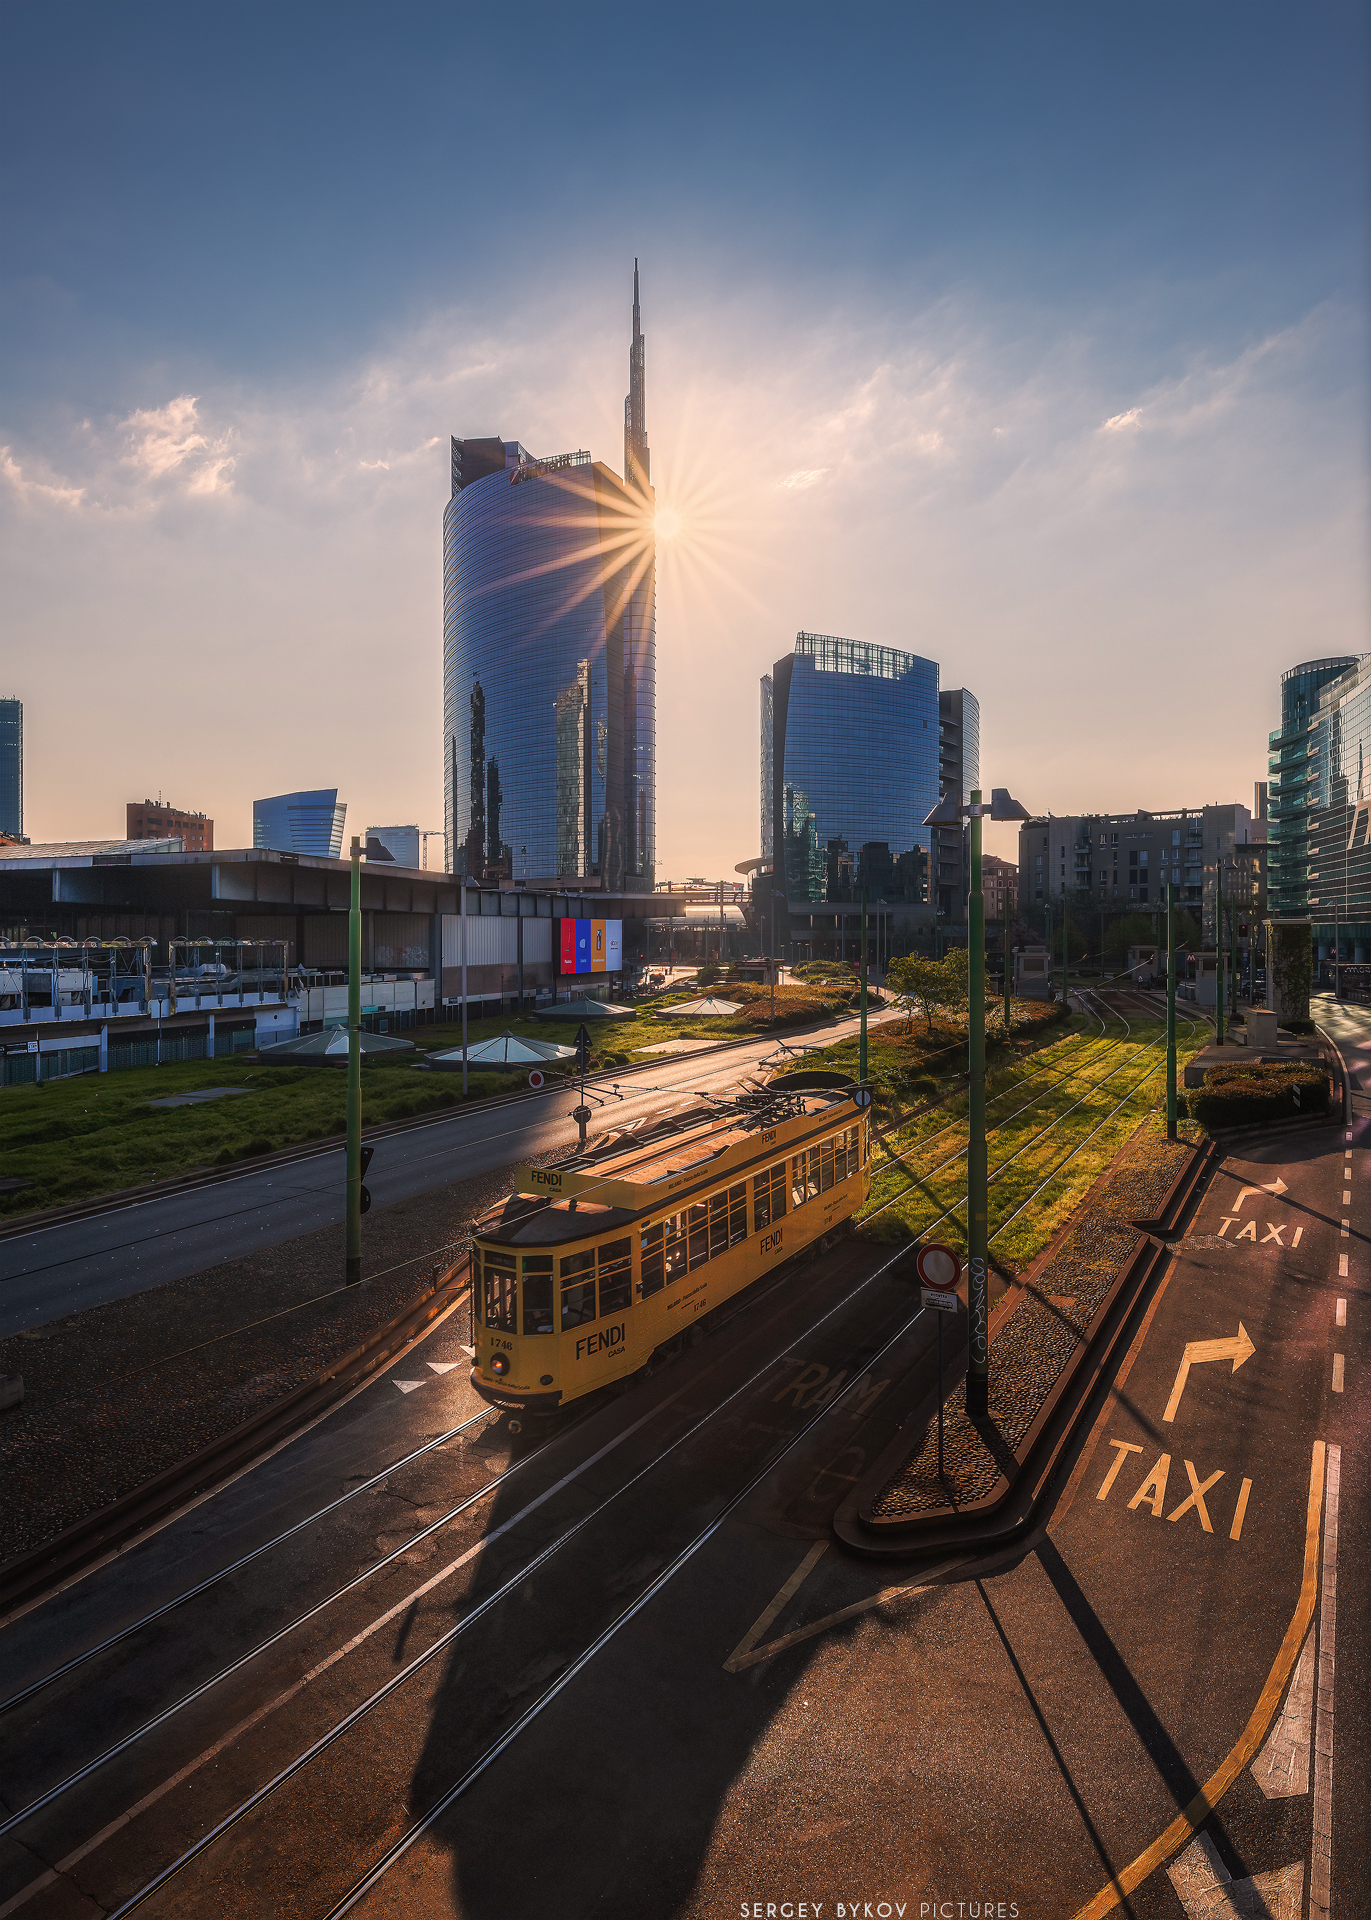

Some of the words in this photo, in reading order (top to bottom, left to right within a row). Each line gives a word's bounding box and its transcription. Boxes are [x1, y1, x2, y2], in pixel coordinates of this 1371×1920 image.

[761, 1129, 777, 1145] FENDI
[531, 1170, 562, 1186] FENDI
[760, 1228, 783, 1255] FENDI
[1215, 1216, 1305, 1249] TAXI
[575, 1323, 626, 1361] FENDI
[607, 1346, 626, 1358] CASA
[752, 1356, 892, 1421] TRAM
[1096, 1438, 1252, 1541] TAXI
